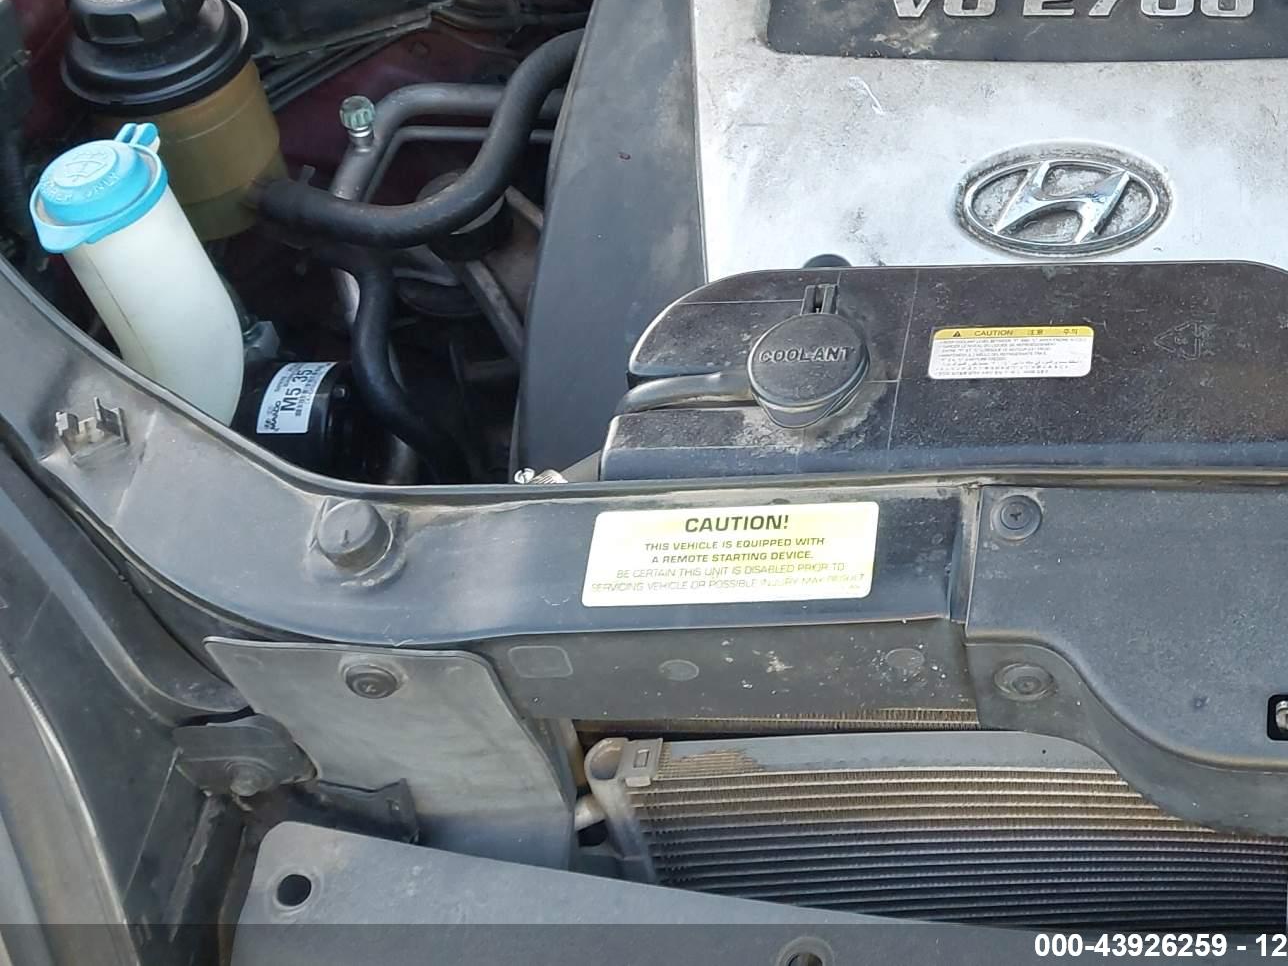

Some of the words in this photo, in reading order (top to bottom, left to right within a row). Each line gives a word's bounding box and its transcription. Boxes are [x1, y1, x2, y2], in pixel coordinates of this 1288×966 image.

[973, 329, 1014, 337] CAUTION
[760, 345, 851, 363] COOLANT
[280, 387, 302, 412] M5
[684, 514, 789, 533] CAUTION!
[645, 542, 670, 551] THIS
[673, 541, 718, 550] VEHICLE
[722, 540, 732, 548] IS
[736, 538, 792, 548] EQUIPPED
[795, 537, 825, 546] WITH
[662, 554, 709, 564] REMOTE
[711, 552, 768, 562] STARTING
[616, 569, 631, 579] BE
[632, 568, 676, 578] CERTAIN
[678, 567, 702, 577] THIS
[704, 566, 729, 576] UNIT
[731, 565, 742, 575] IS
[744, 564, 795, 574] DISABLED
